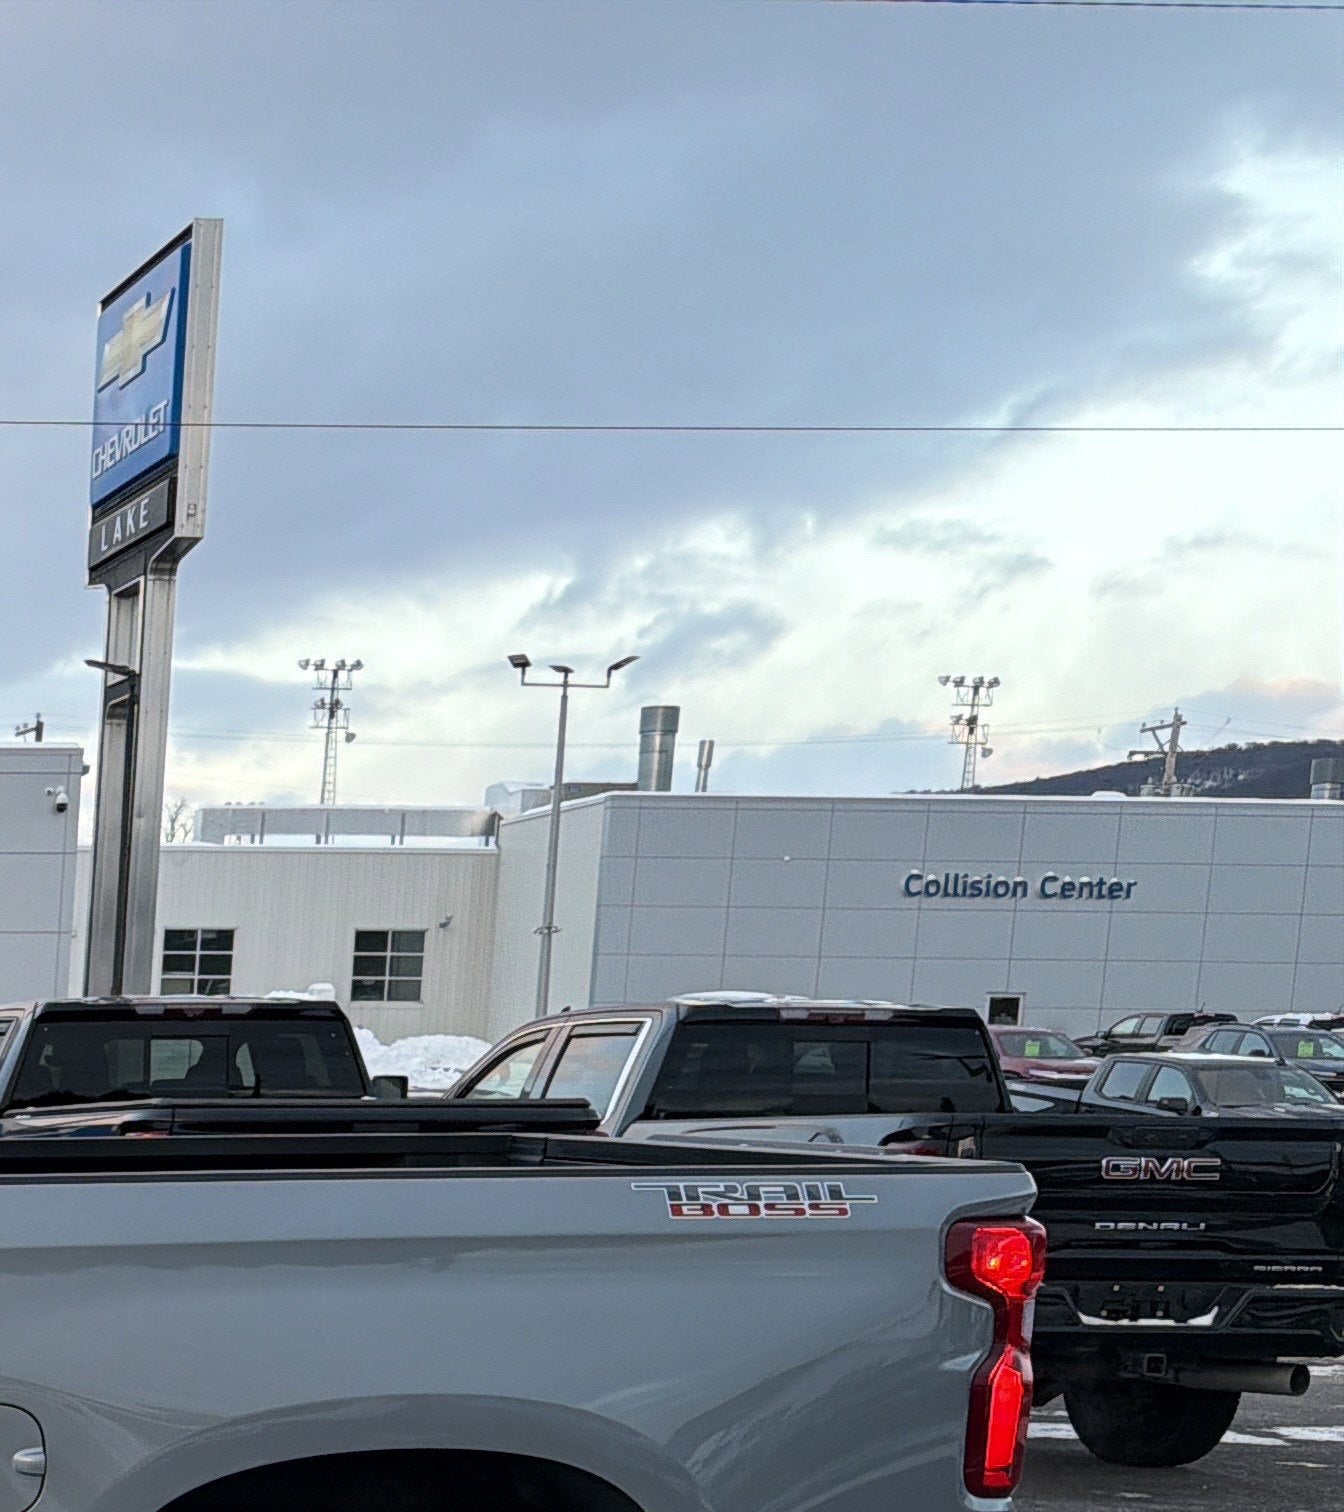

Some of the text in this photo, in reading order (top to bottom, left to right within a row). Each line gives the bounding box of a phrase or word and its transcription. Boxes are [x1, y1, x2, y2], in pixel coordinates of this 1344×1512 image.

[91, 400, 169, 480] CHEVROLET
[100, 497, 151, 552] LAKE
[904, 870, 1139, 900] Collision Center
[1101, 1156, 1222, 1181] GMC
[630, 1181, 879, 1203] TRAIL
[668, 1201, 852, 1220] BOSS
[1094, 1222, 1207, 1232] DENALI
